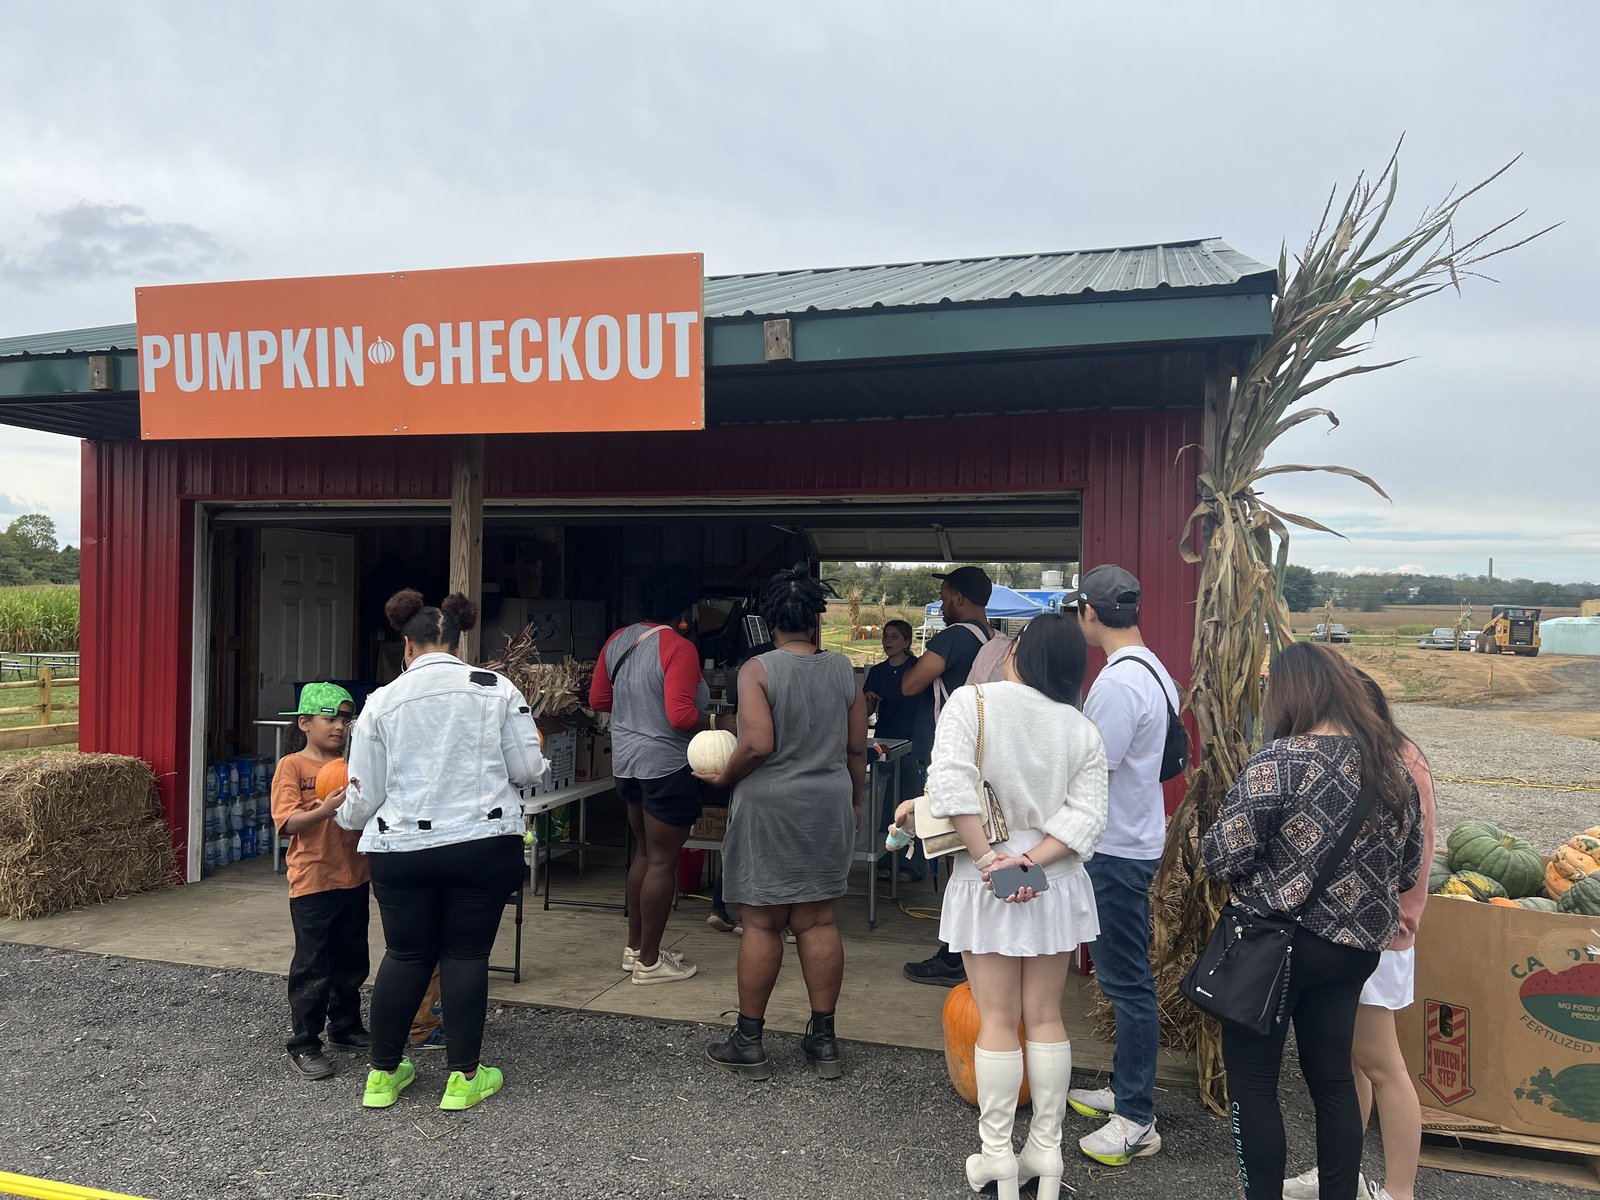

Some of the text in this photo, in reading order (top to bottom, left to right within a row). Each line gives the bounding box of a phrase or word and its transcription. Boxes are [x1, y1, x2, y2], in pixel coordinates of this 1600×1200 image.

[142, 311, 698, 393] PUMPKIN CHECKOUT
[300, 777, 316, 791] MI
[1510, 946, 1597, 979] CADY
[1558, 1002, 1571, 1010] MG
[1572, 1003, 1595, 1012] FORD
[1571, 1011, 1600, 1021] PRODU
[1519, 1014, 1593, 1053] FERTILIZED
[1434, 1048, 1460, 1071] WATCH
[1437, 1071, 1457, 1088] STEP
[1231, 1101, 1241, 1134] CLUB
